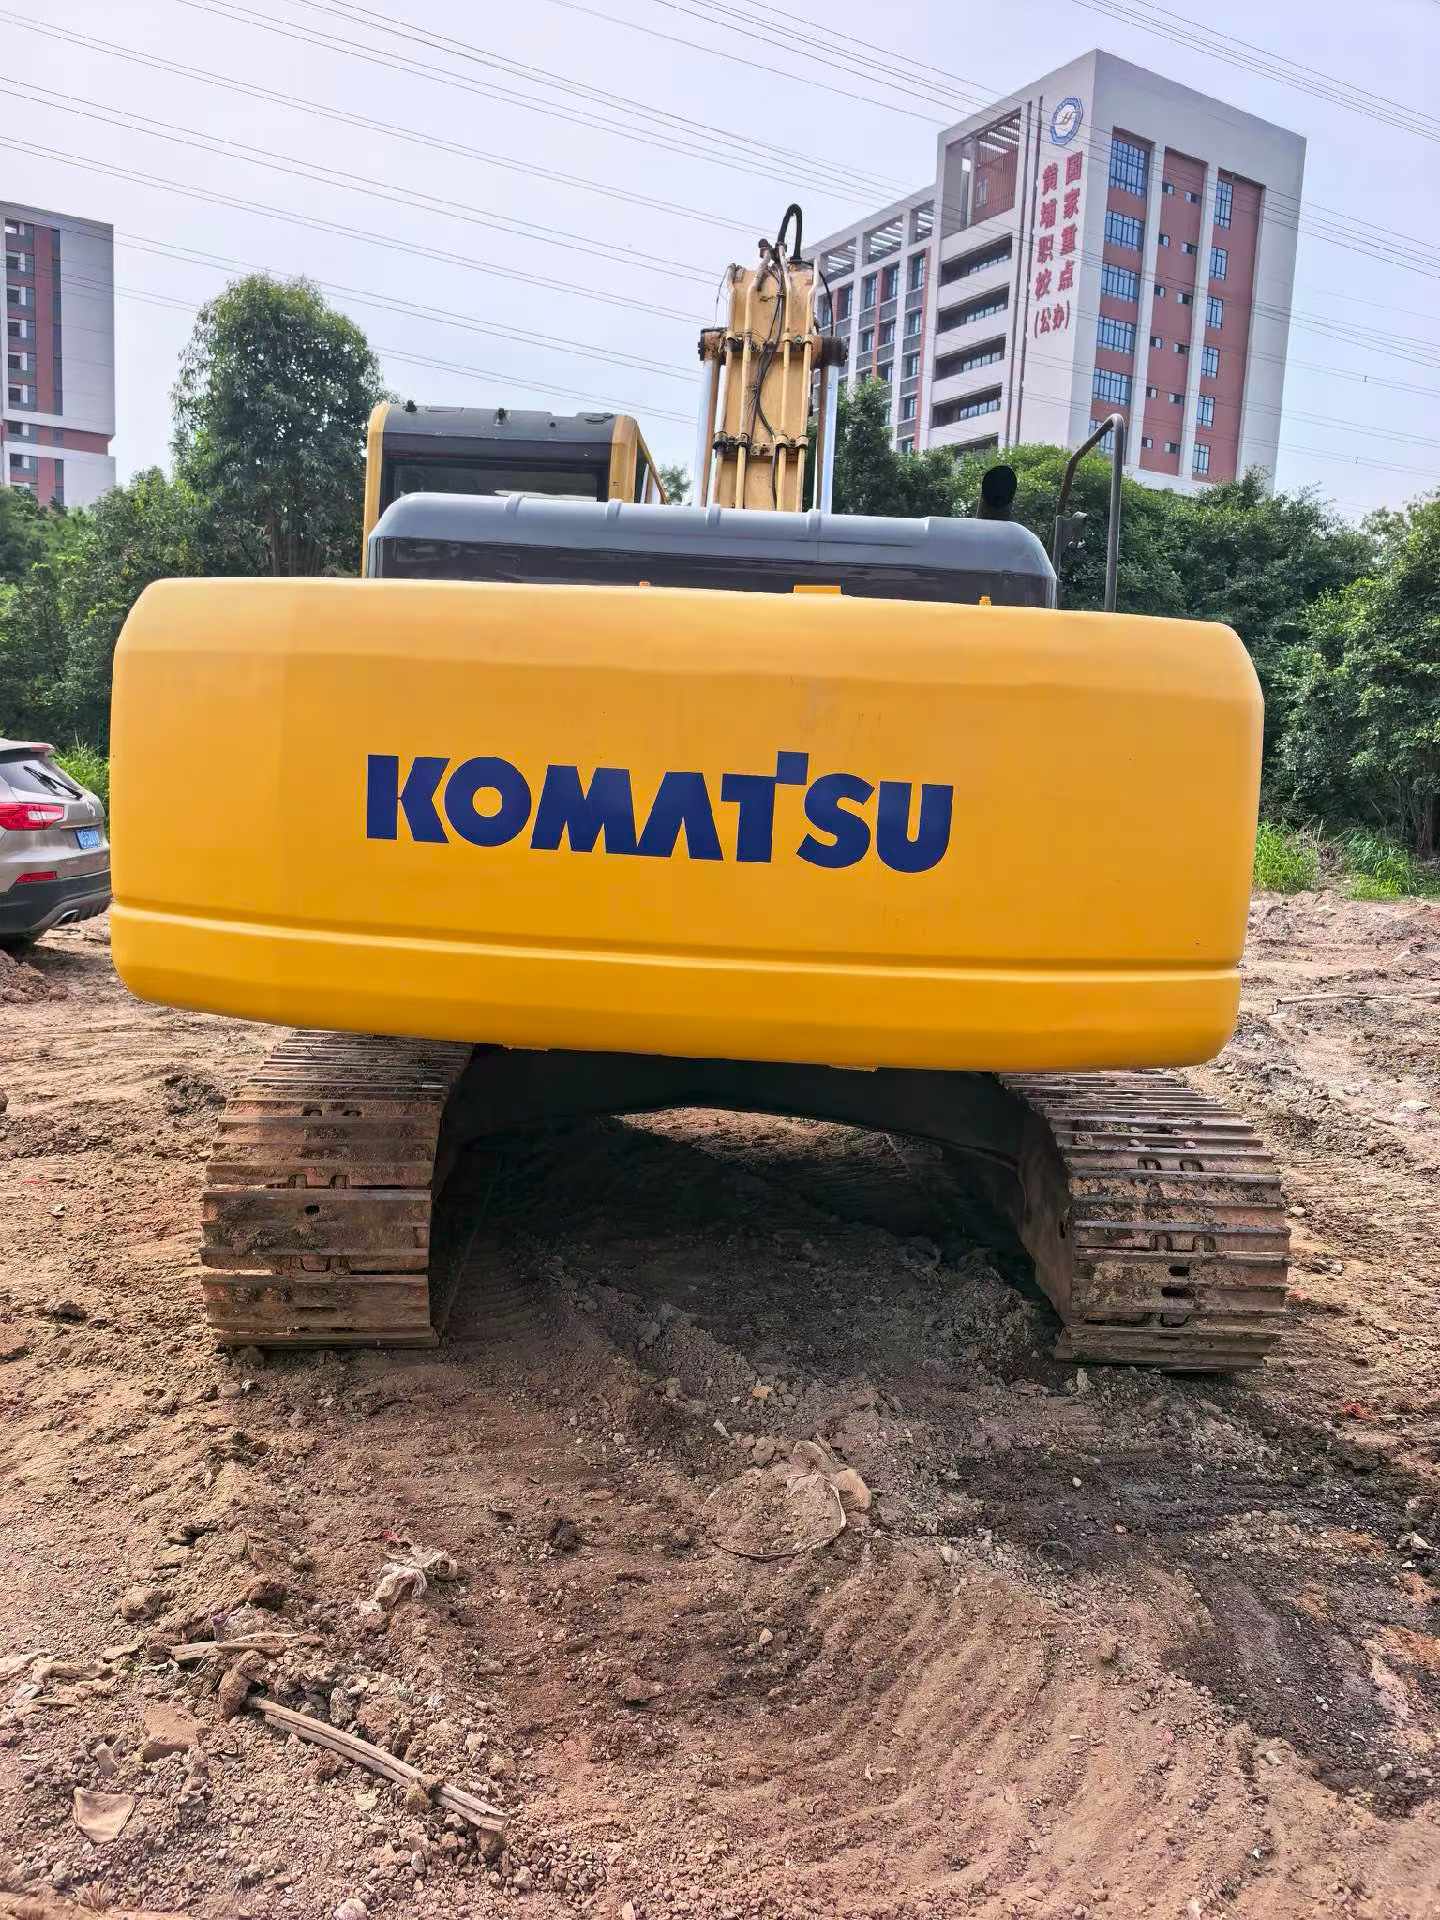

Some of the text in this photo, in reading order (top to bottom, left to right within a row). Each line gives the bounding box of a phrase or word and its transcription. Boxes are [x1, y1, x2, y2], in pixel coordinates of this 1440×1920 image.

[1058, 151, 1083, 291] 国家重点
[366, 750, 954, 873] KOMATSU
